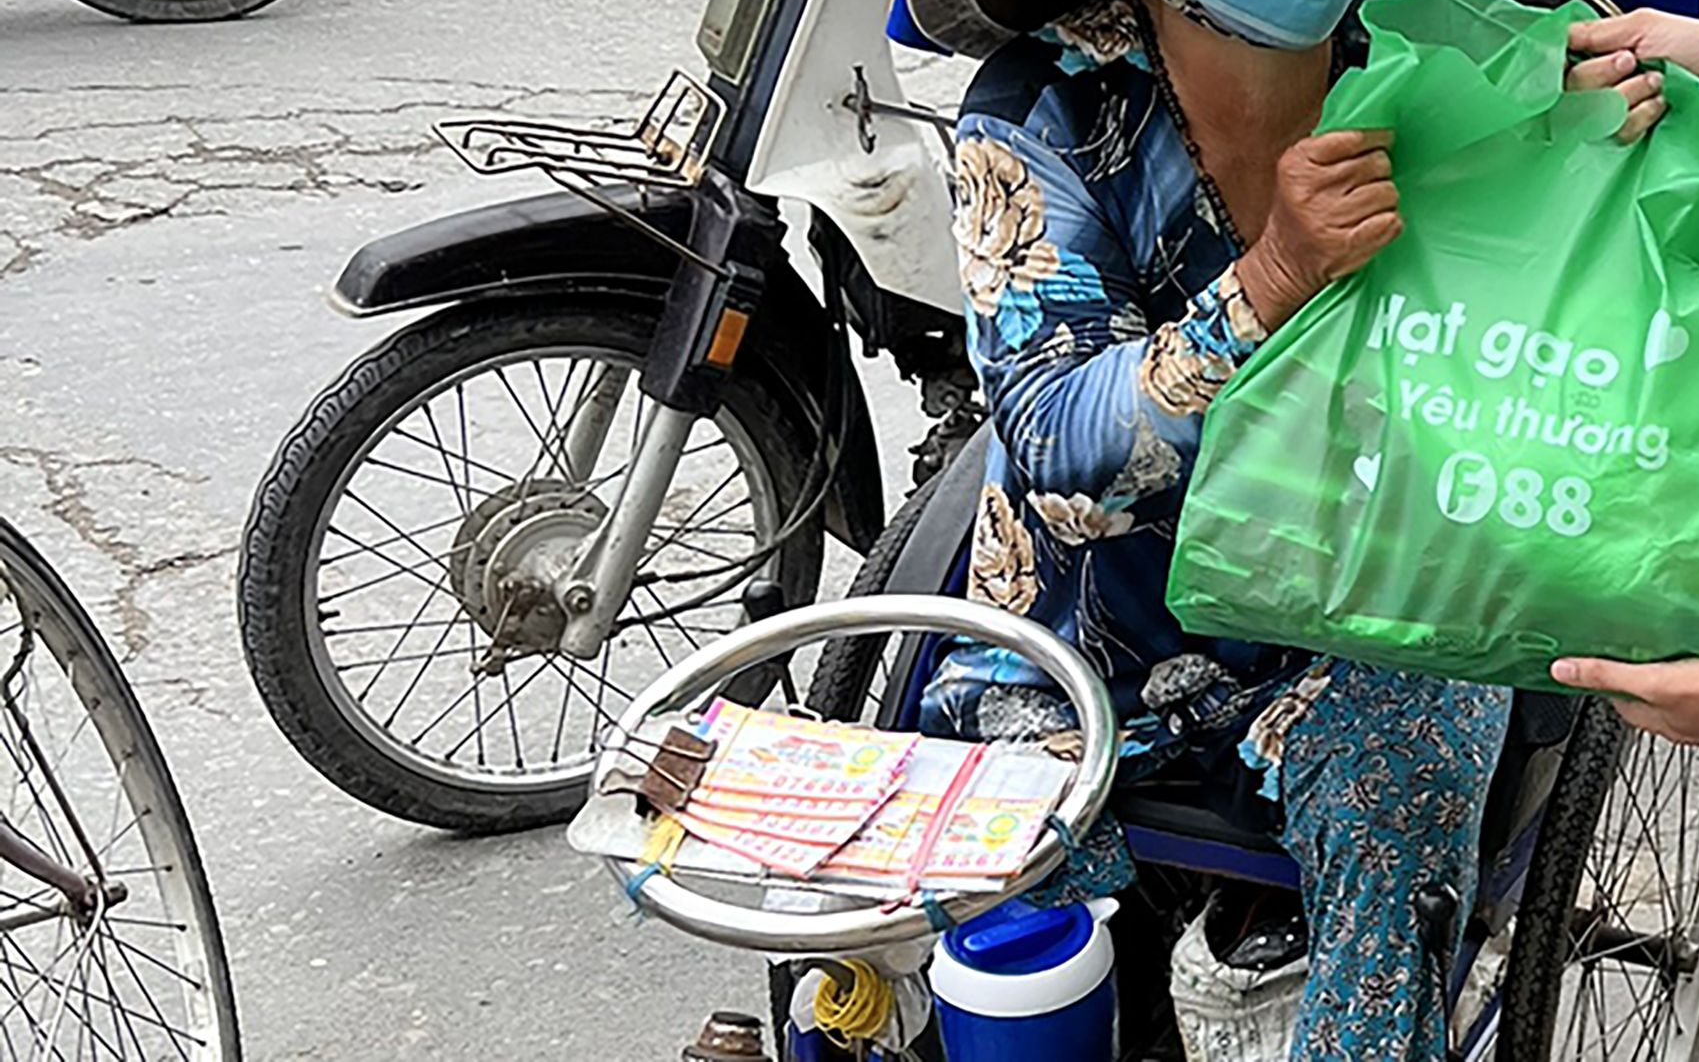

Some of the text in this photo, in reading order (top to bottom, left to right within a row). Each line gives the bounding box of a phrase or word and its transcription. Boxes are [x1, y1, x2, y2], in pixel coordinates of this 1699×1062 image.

[1366, 293, 1620, 387] Hạt gạo
[1400, 378, 1670, 470] Yêu thương
[1436, 450, 1593, 537] F88
